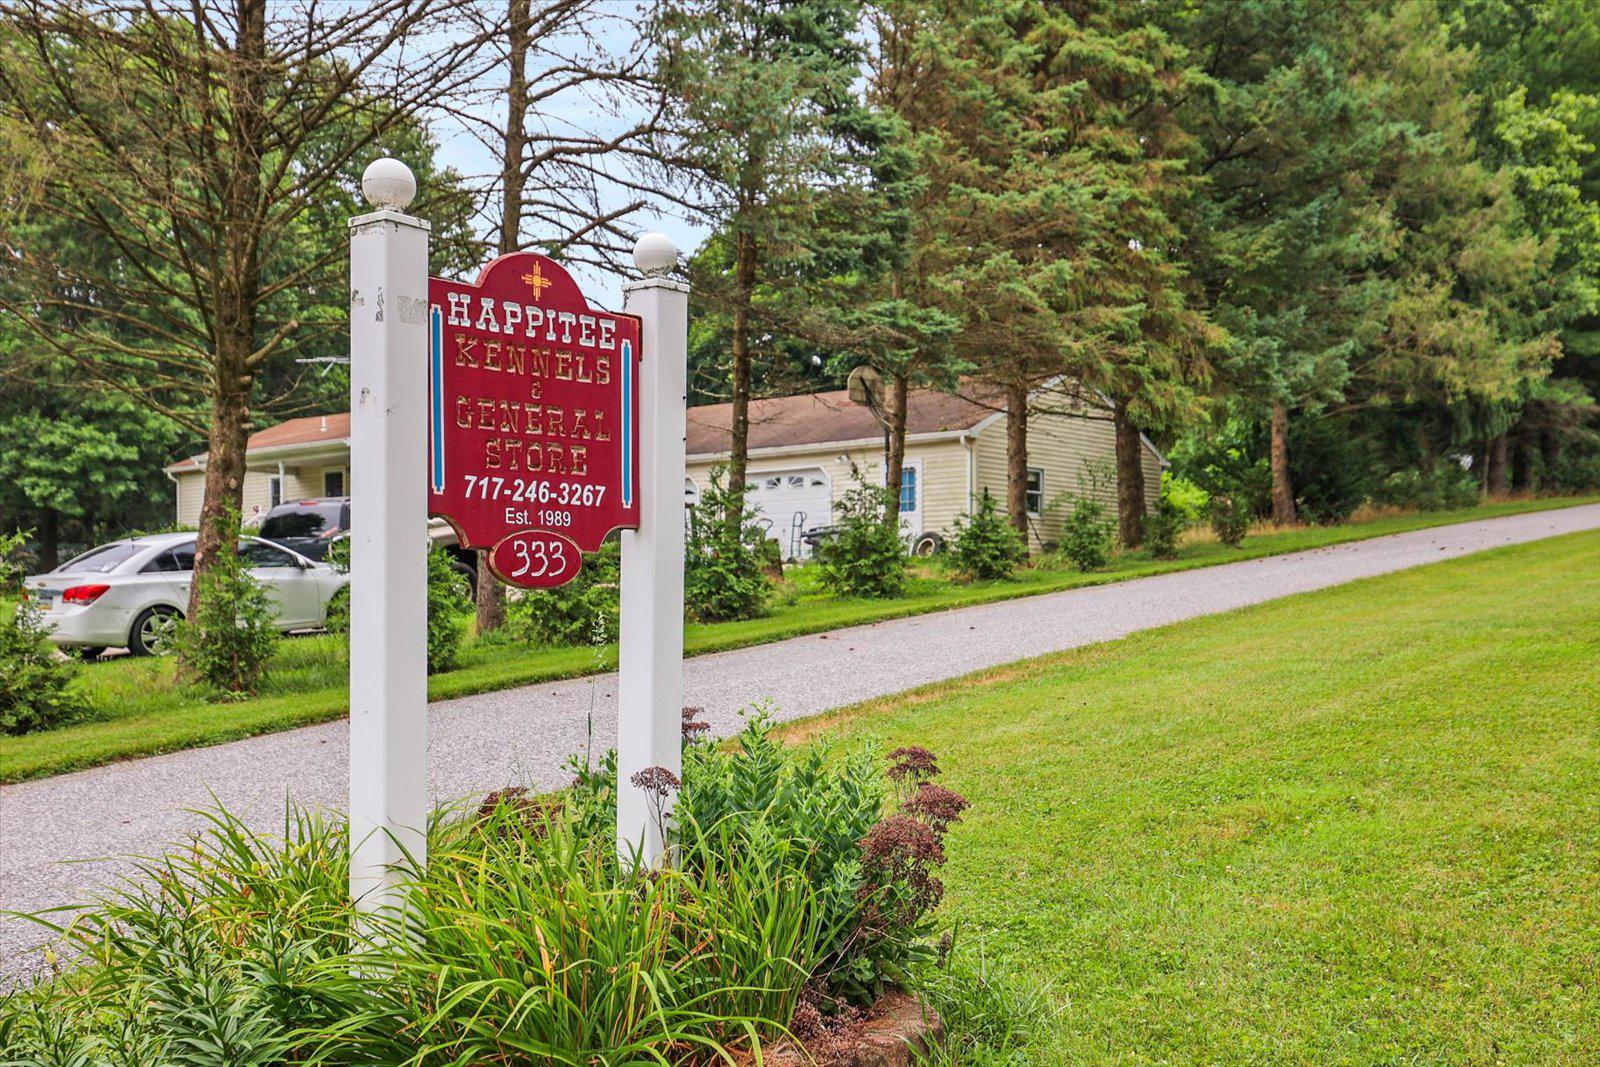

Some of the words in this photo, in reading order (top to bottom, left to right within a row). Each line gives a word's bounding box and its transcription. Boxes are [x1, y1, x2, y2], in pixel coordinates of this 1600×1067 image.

[447, 291, 616, 350] HAPPITEE
[455, 333, 611, 385] KENNELS
[531, 380, 542, 399] &
[456, 394, 611, 441] GENERAL
[485, 437, 587, 476] STORE
[464, 475, 606, 507] 717-246-3267
[505, 507, 532, 525] Est.
[538, 510, 571, 526] 1989
[511, 539, 566, 577] 333
